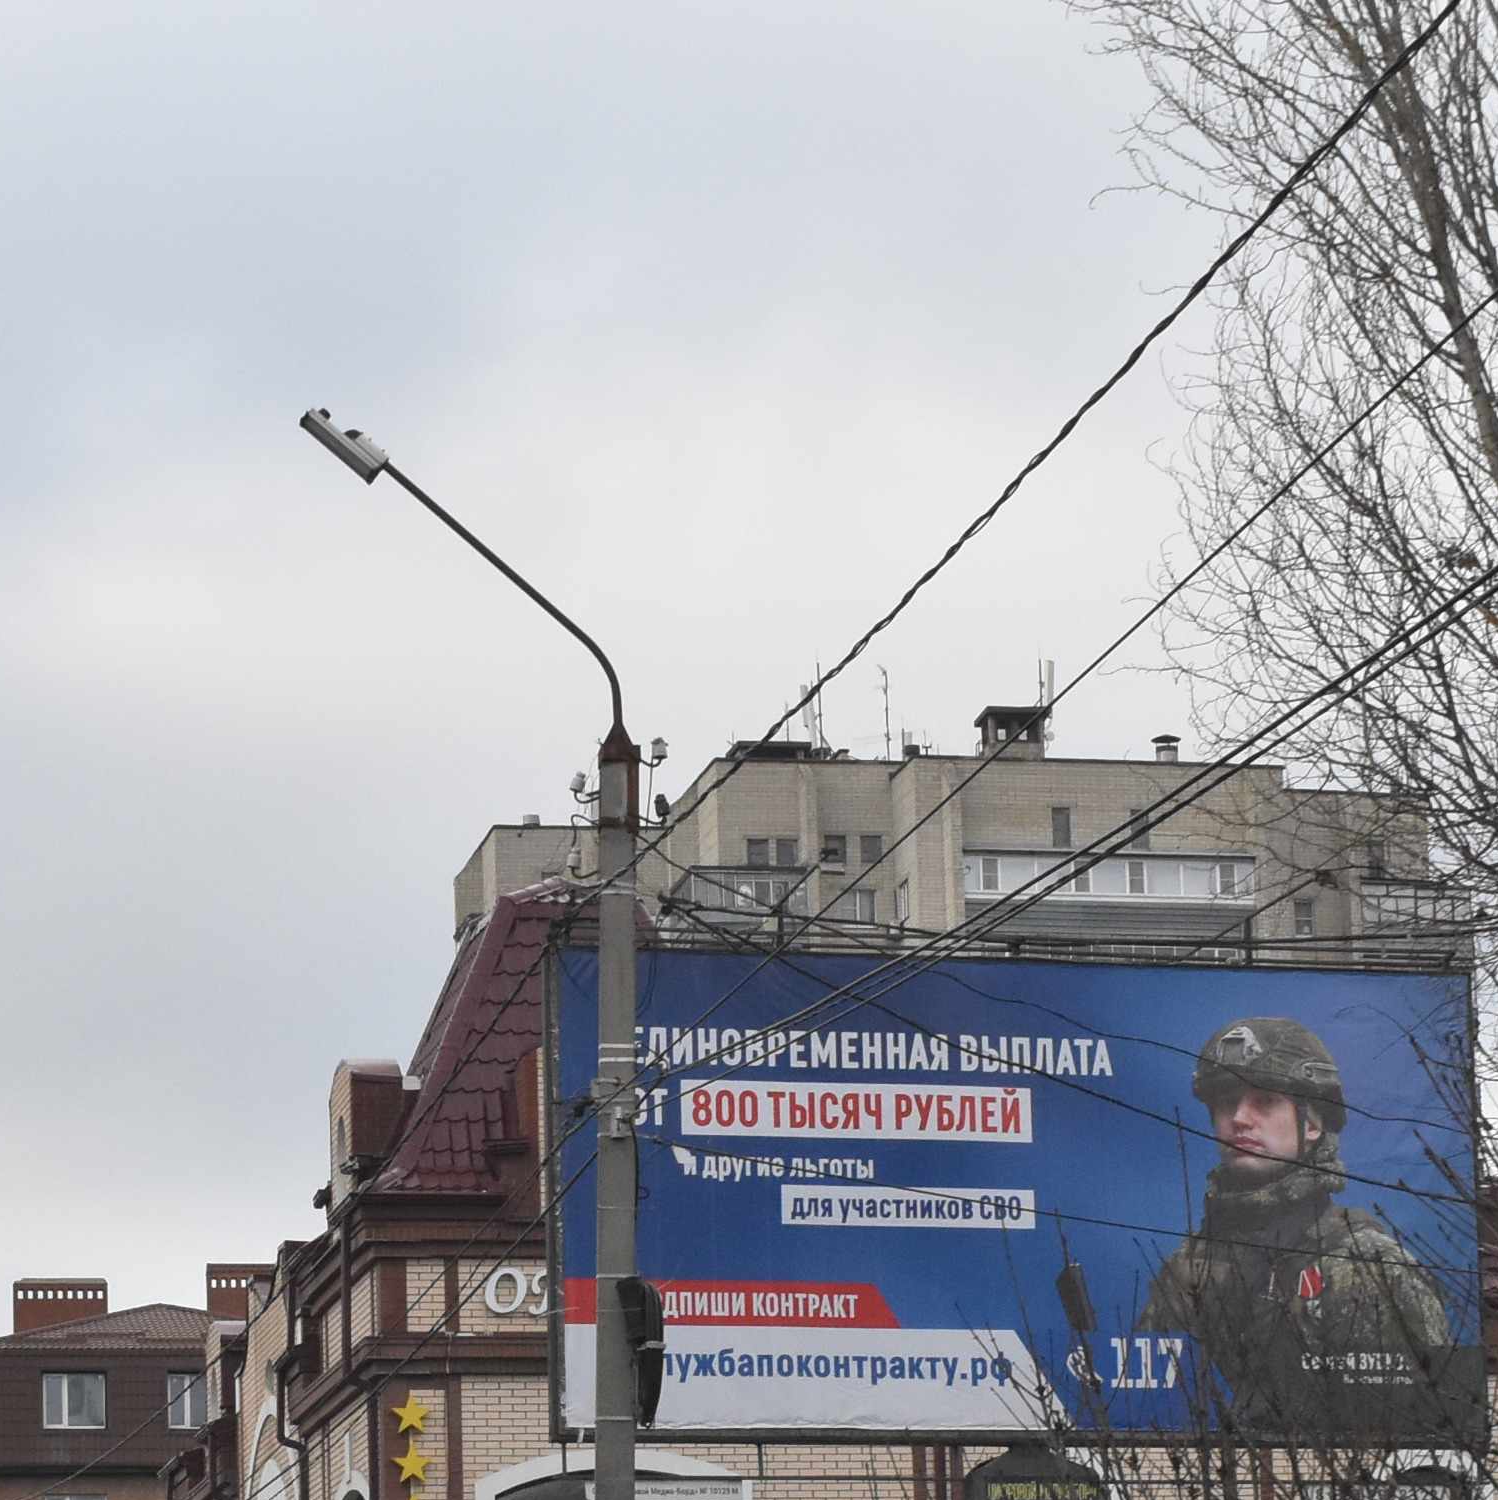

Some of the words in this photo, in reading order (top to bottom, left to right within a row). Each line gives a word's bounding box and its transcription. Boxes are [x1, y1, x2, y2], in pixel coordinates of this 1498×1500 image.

[959, 1034, 1113, 1077] ВЫПЛАТА
[692, 1089, 759, 1127] 800
[767, 1091, 882, 1130] ТЫСЯЧ
[894, 1088, 1021, 1134] РУБЛЕЙ
[702, 1157, 784, 1181] другие
[789, 1158, 875, 1179] льготы
[791, 1197, 833, 1219] для
[841, 1196, 973, 1223] участников
[979, 1195, 1022, 1221] СВО
[661, 1291, 746, 1319] ДПИШИ
[753, 1292, 858, 1319] КОНТРАКТ
[663, 1347, 1013, 1386] лужбапоконтракту.рф
[1110, 1338, 1183, 1389] 117
